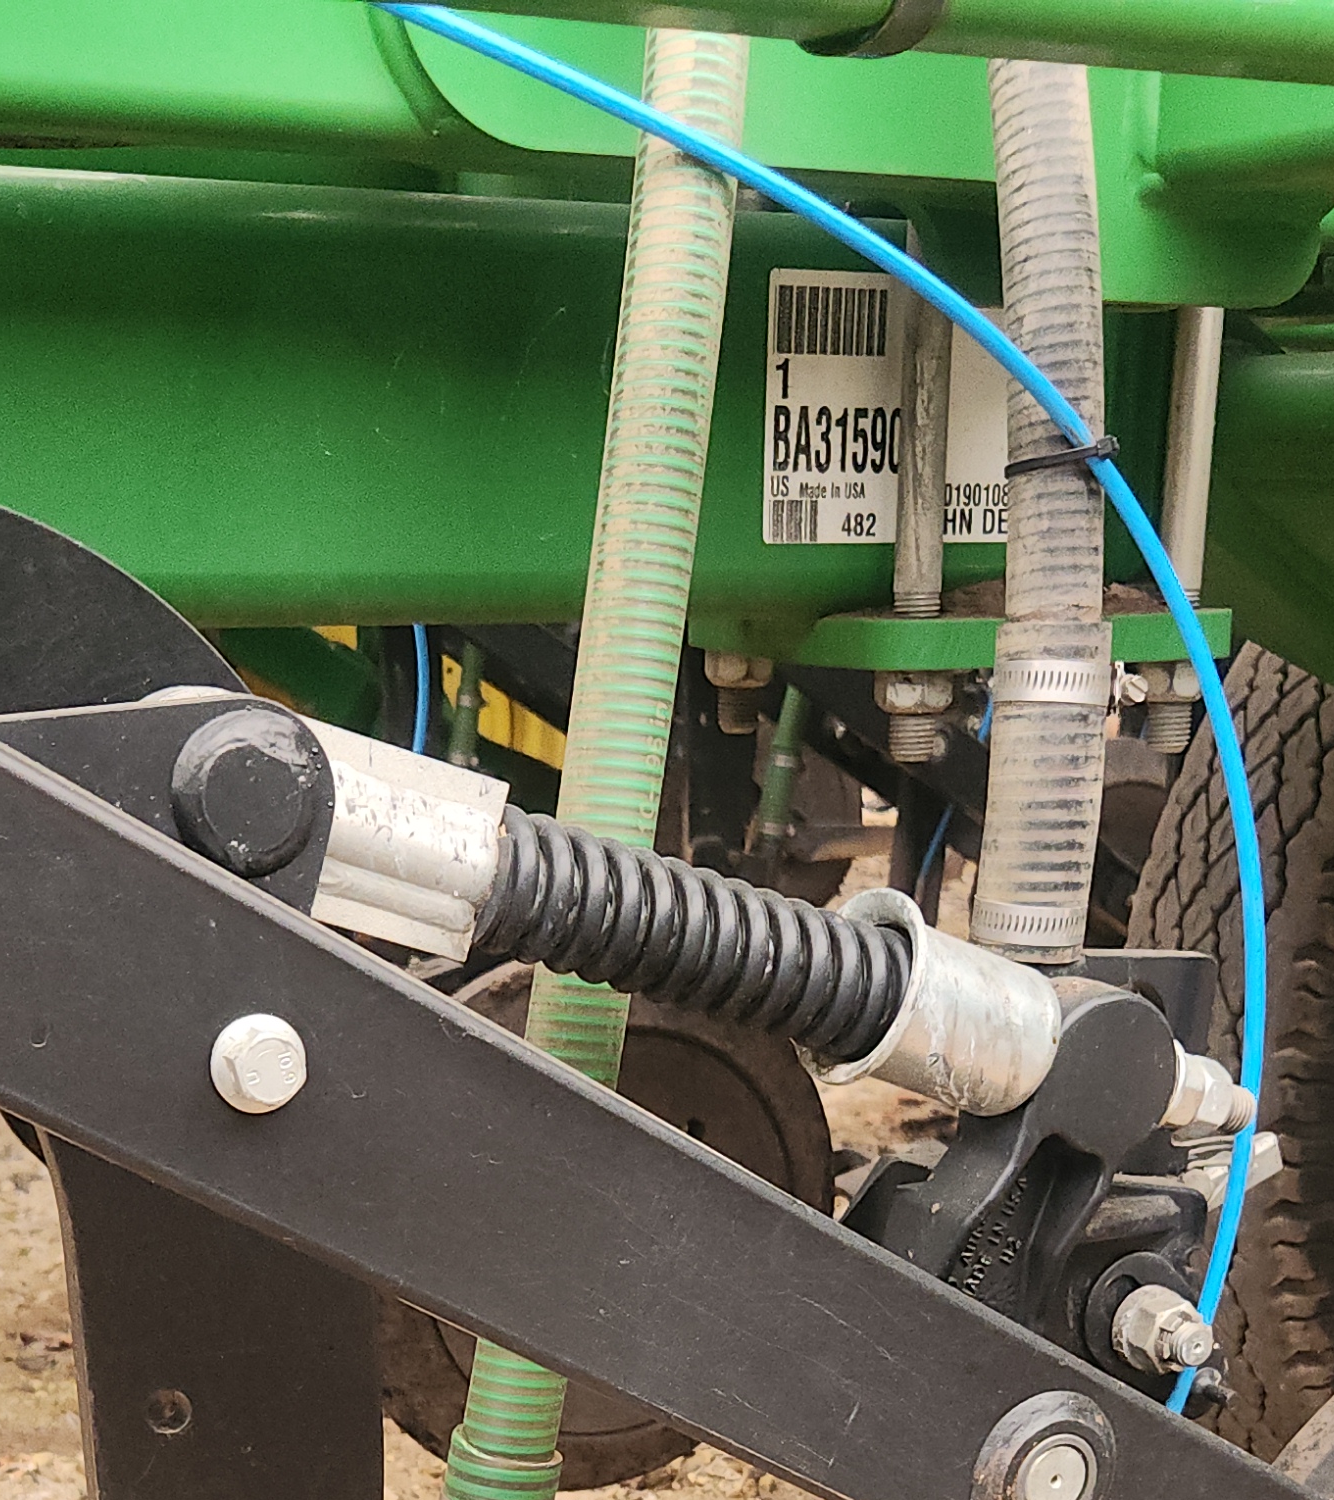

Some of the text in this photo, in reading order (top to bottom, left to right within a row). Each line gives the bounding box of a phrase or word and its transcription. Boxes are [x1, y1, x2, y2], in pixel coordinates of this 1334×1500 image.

[775, 358, 791, 400] 1
[772, 405, 901, 475] BA31590
[770, 475, 866, 499] US Made In USA
[841, 512, 877, 537] 482
